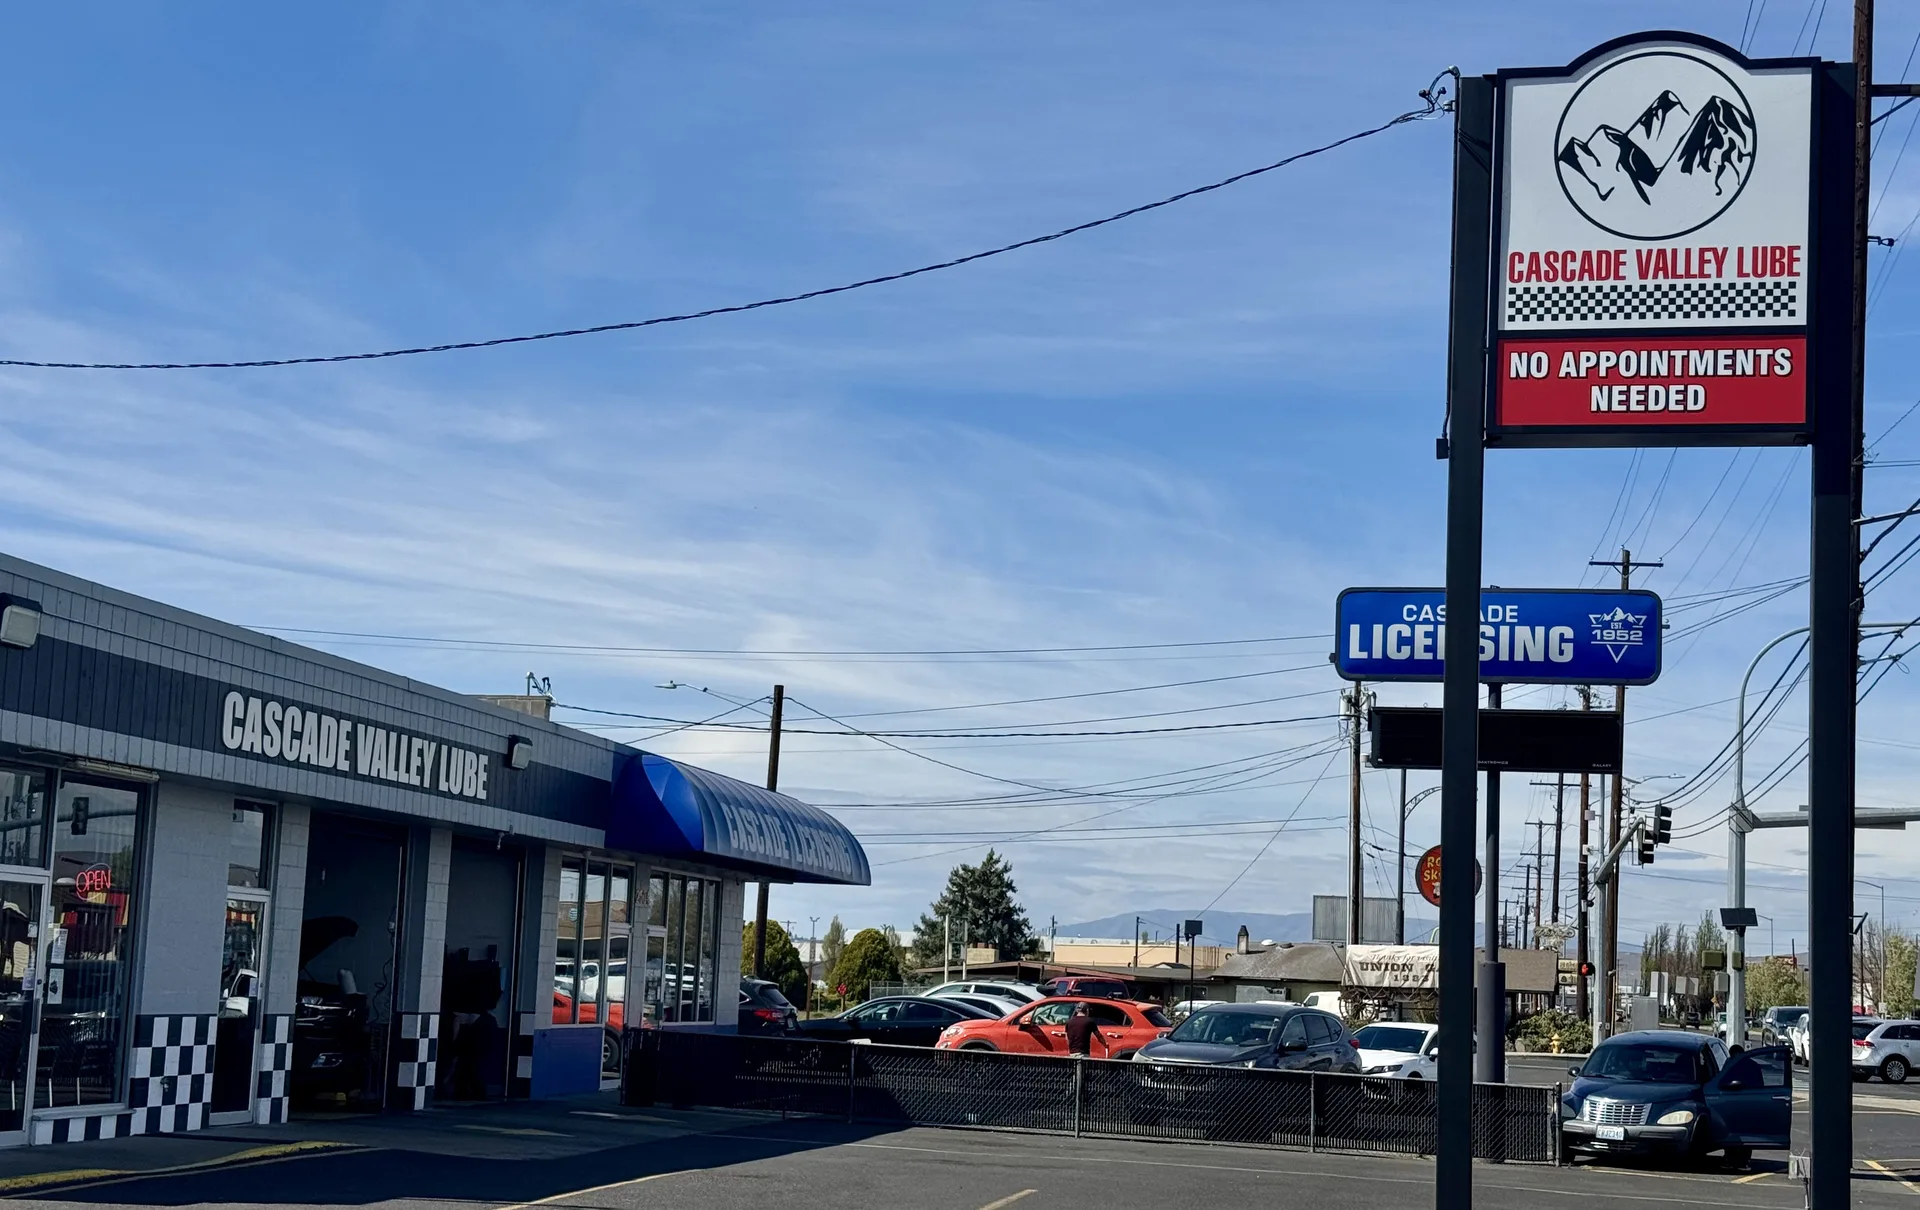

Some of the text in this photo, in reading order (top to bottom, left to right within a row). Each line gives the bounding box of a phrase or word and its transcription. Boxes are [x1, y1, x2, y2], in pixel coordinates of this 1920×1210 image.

[1508, 245, 1801, 283] CASCADE VALLEY LUBE
[1509, 348, 1793, 379] NO APPOINTMENTS
[1590, 384, 1706, 413] NEEDED
[1402, 604, 1518, 623] CASADE
[1610, 621, 1624, 630] EST.
[1349, 624, 1574, 663] LICESING
[1591, 629, 1643, 642] 1952
[222, 691, 489, 801] CASCADE VALLEY LUBE
[721, 803, 790, 860] CASCADE
[76, 869, 111, 892] OPEN
[1358, 961, 1414, 972] UNION
